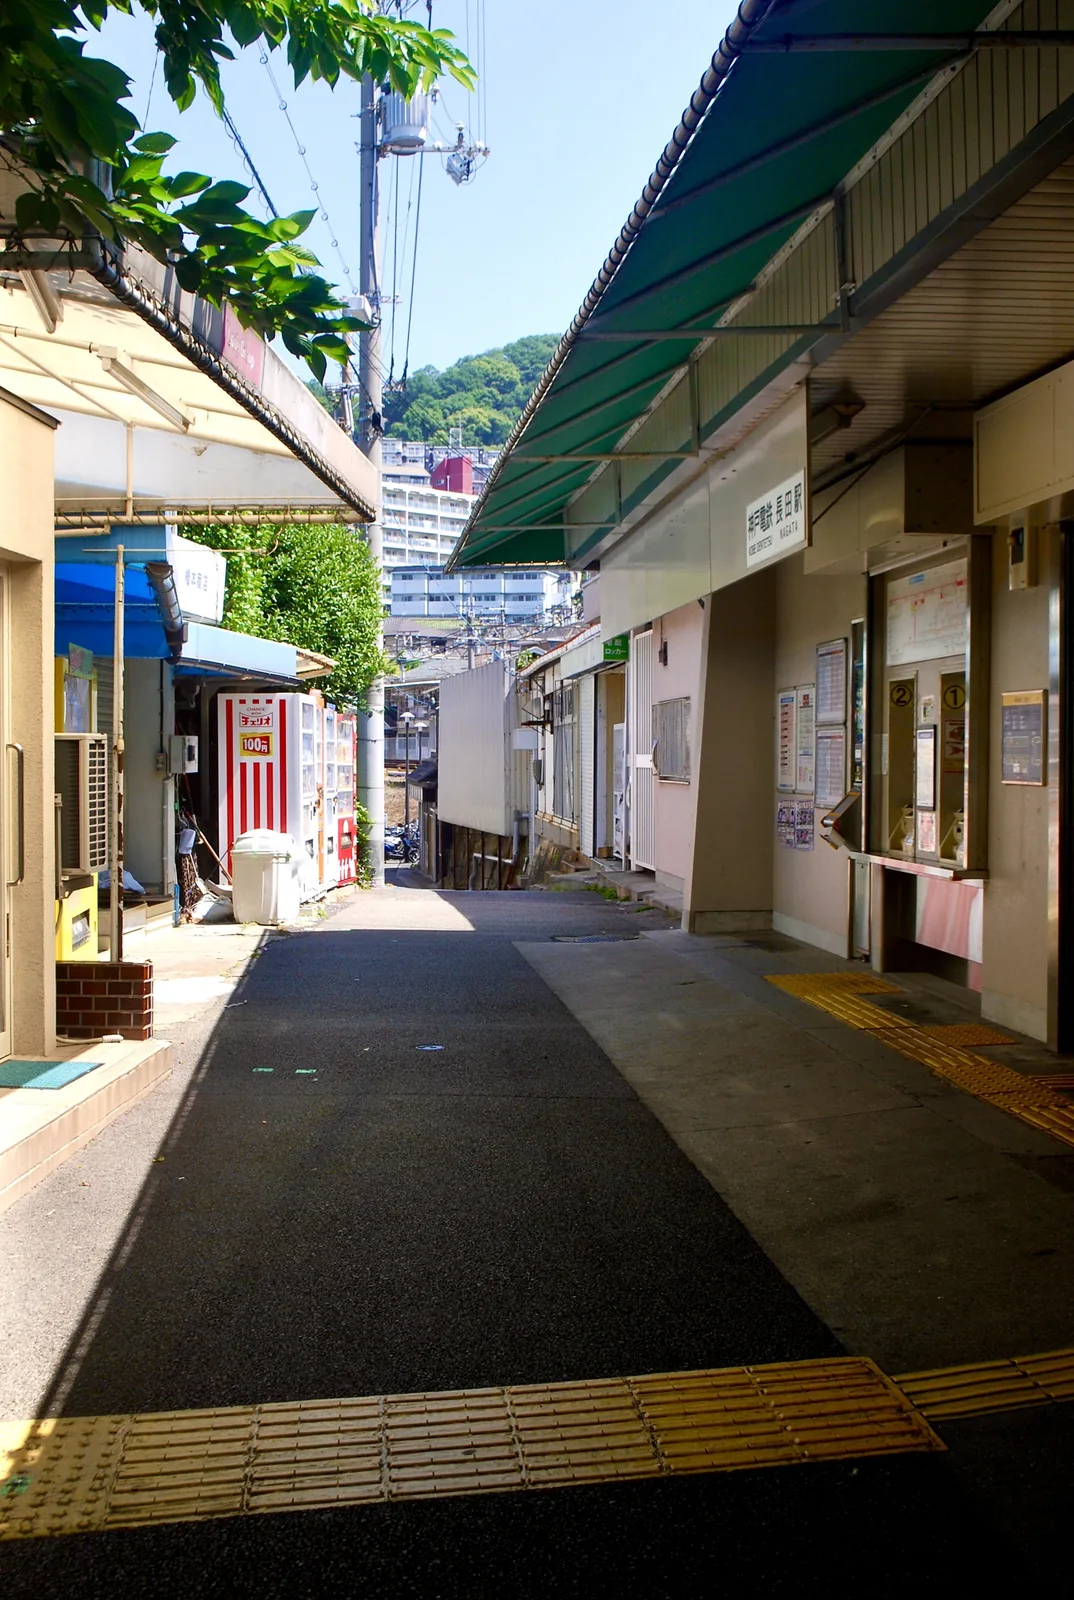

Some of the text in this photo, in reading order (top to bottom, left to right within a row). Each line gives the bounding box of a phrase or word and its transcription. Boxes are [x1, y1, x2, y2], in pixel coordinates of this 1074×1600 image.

[780, 520, 798, 538] NAGATA
[605, 648, 626, 656] ロッカー
[241, 716, 271, 725] チェリオ
